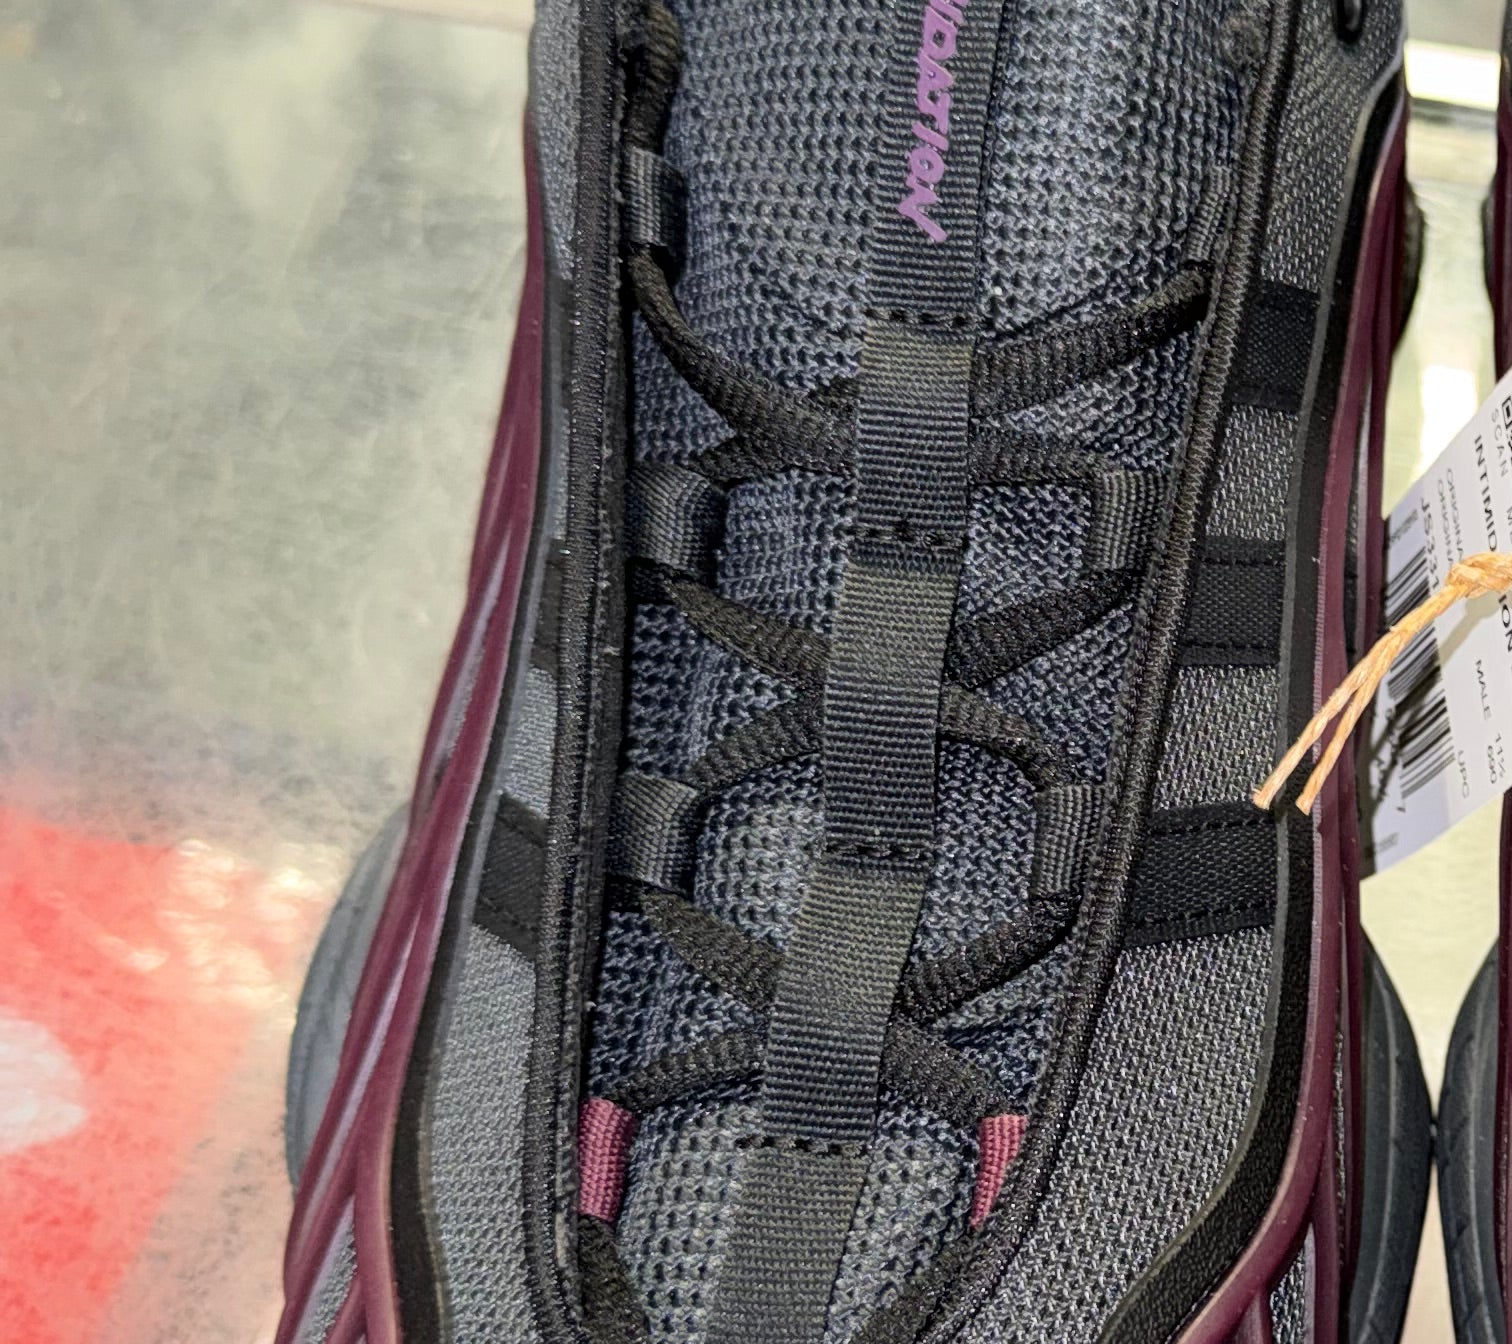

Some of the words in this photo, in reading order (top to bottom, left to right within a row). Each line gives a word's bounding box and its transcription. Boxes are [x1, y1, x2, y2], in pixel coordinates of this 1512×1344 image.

[1491, 408, 1509, 478] SCAN
[1475, 659, 1492, 721] MALE
[1456, 750, 1470, 799] UPC
